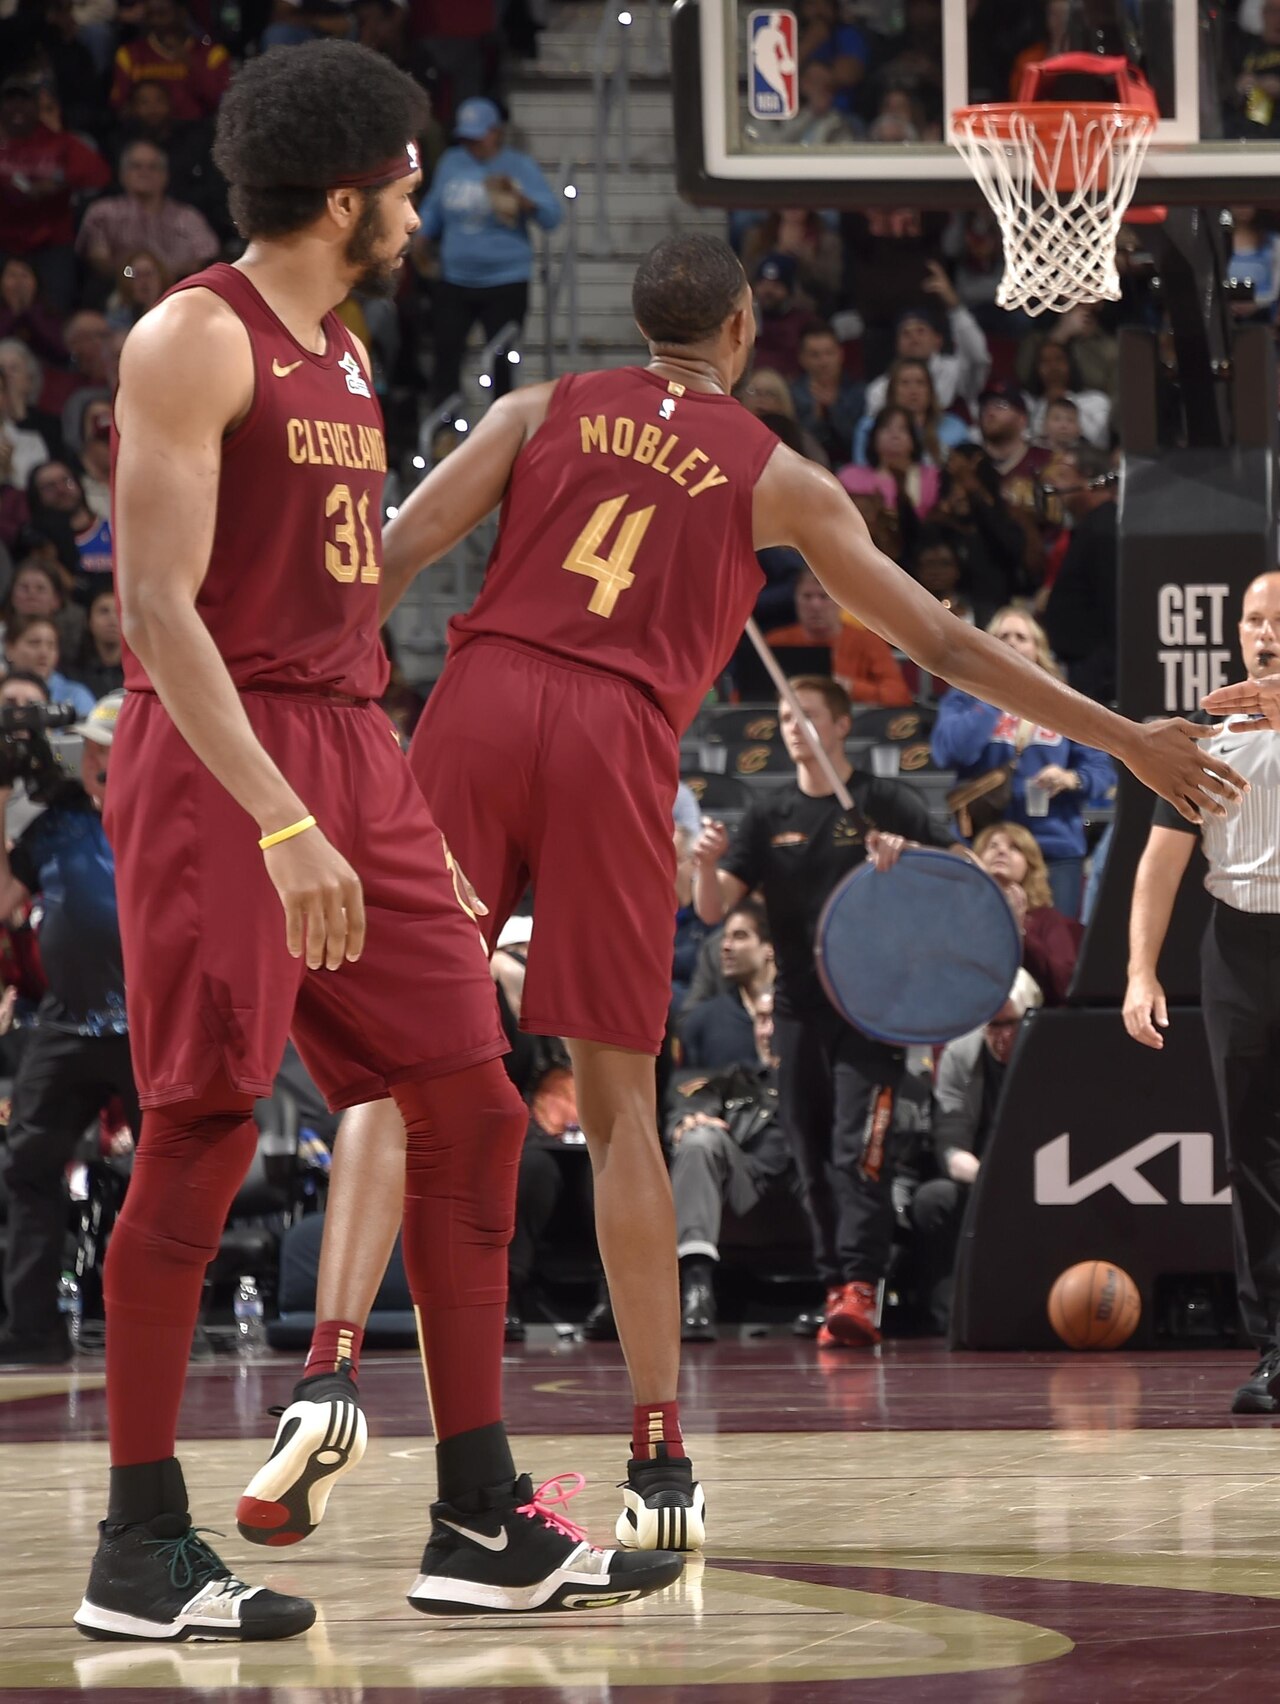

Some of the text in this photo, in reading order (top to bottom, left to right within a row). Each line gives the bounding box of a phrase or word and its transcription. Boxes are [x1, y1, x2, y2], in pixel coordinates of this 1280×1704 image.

[580, 415, 729, 498] MOBLEY
[325, 484, 380, 584] 31
[562, 493, 656, 619] 4
[1158, 584, 1230, 646] GET
[1034, 1132, 1233, 1205] KI
